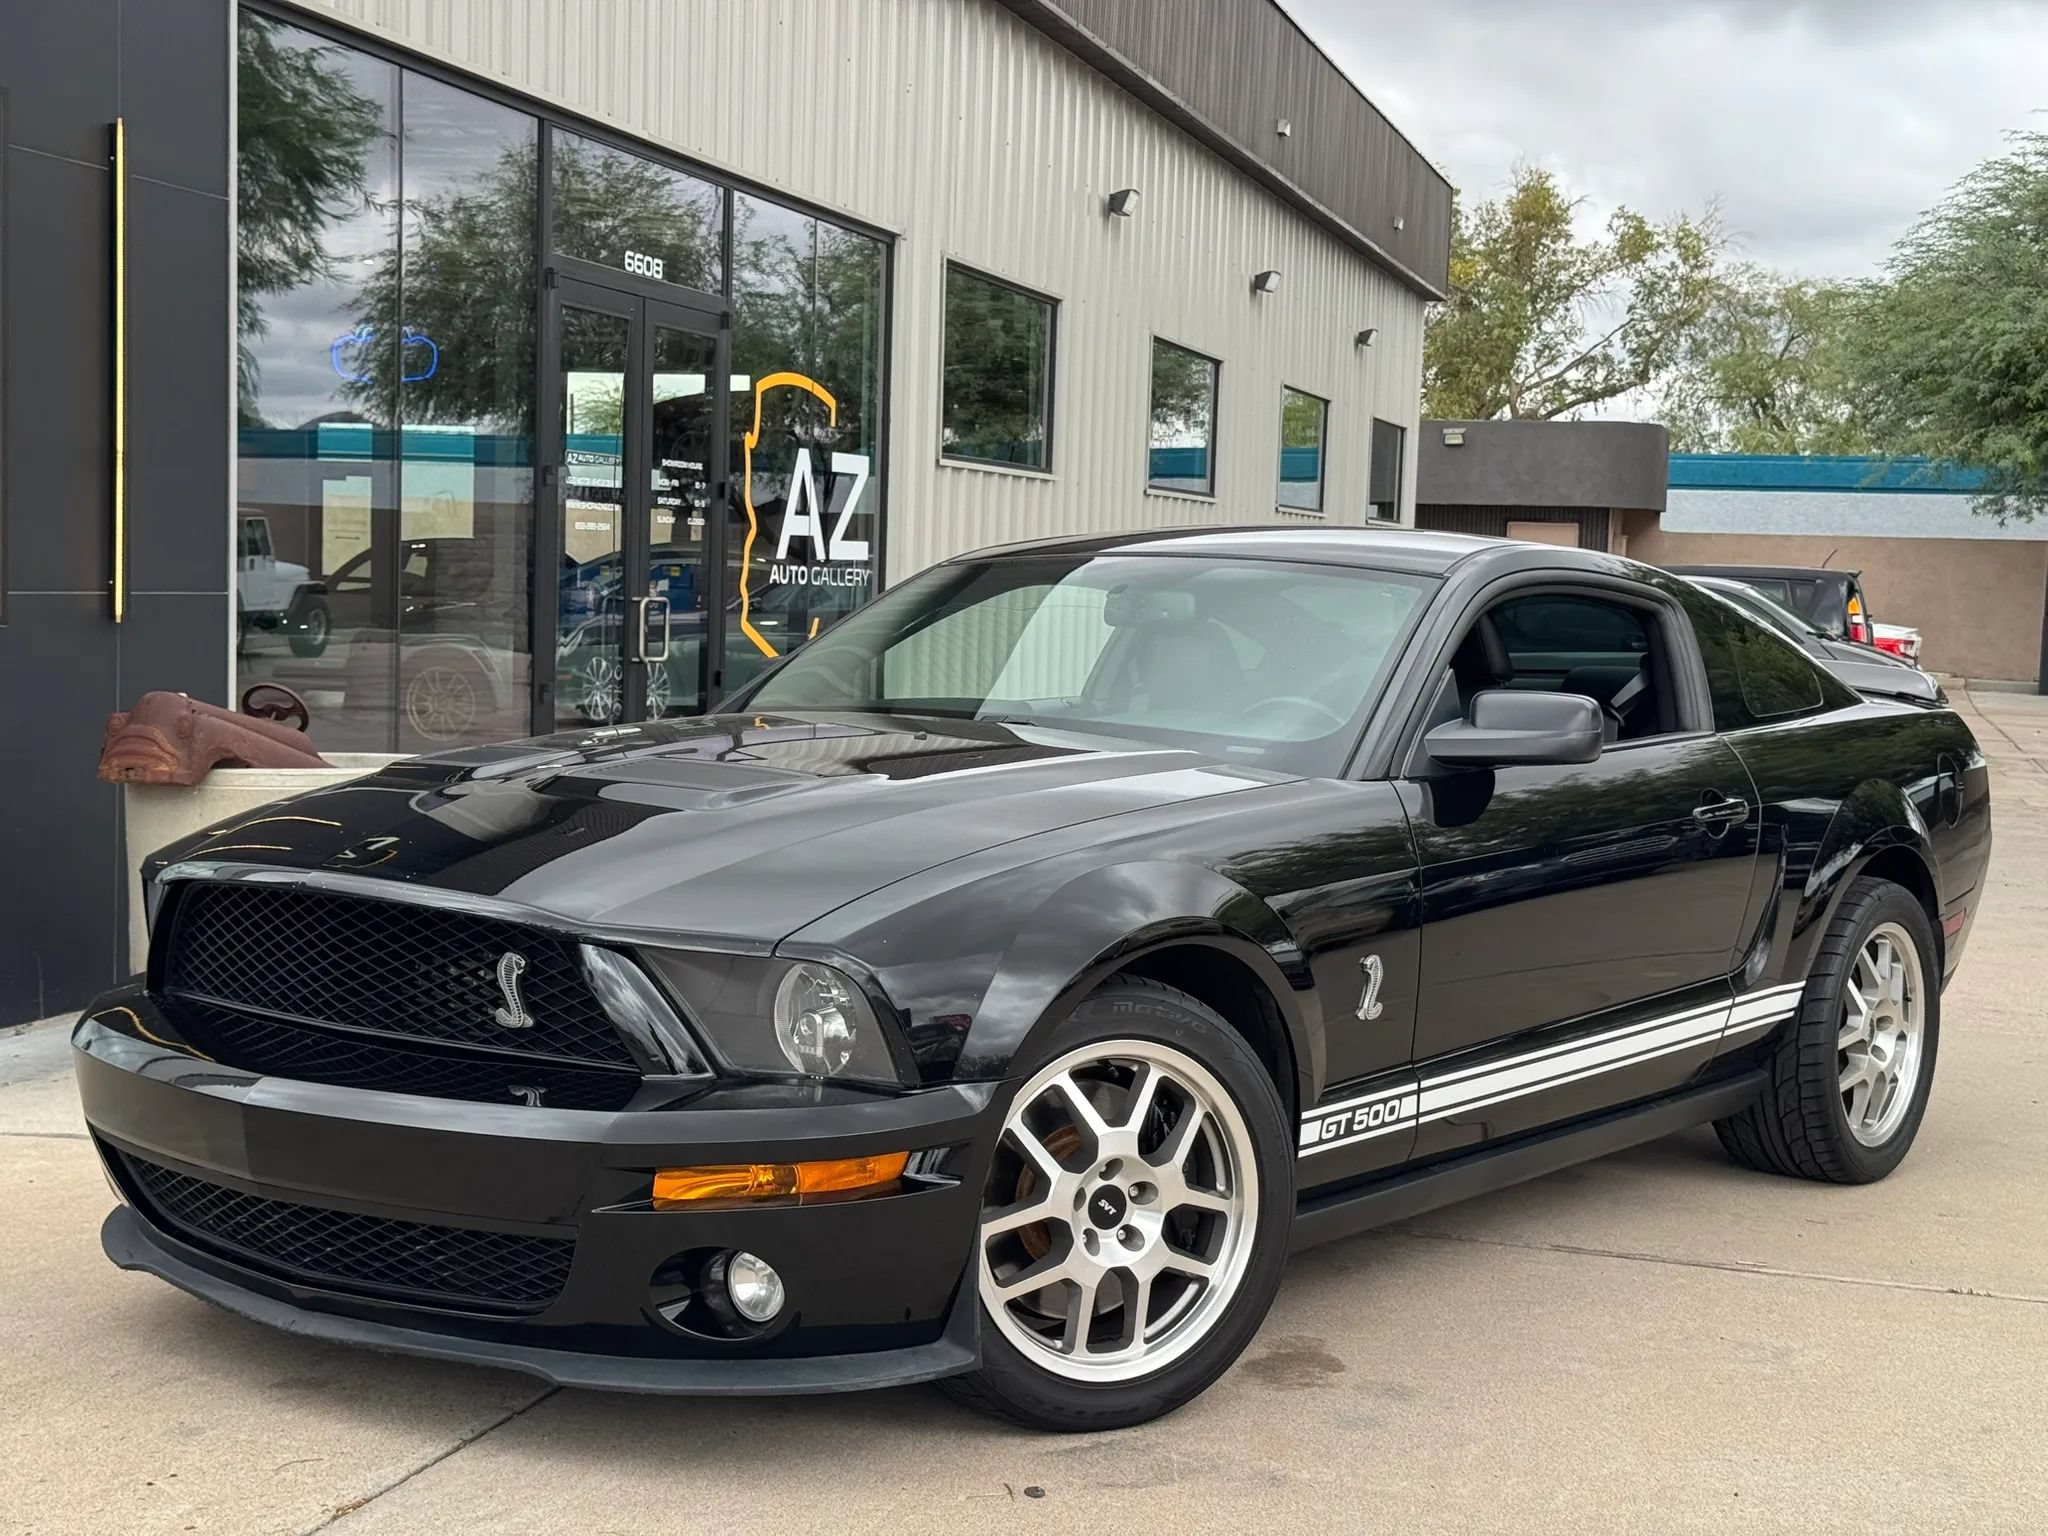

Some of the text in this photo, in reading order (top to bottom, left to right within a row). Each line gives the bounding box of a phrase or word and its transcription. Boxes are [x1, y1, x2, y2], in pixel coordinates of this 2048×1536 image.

[624, 250, 663, 280] 6608
[567, 452, 578, 464] AZ
[578, 454, 594, 463] AUTO
[776, 447, 869, 561] AZ
[769, 564, 870, 586] AUTO GALLERY
[1321, 1099, 1400, 1140] GT 500
[1098, 1199, 1117, 1215] SVT
